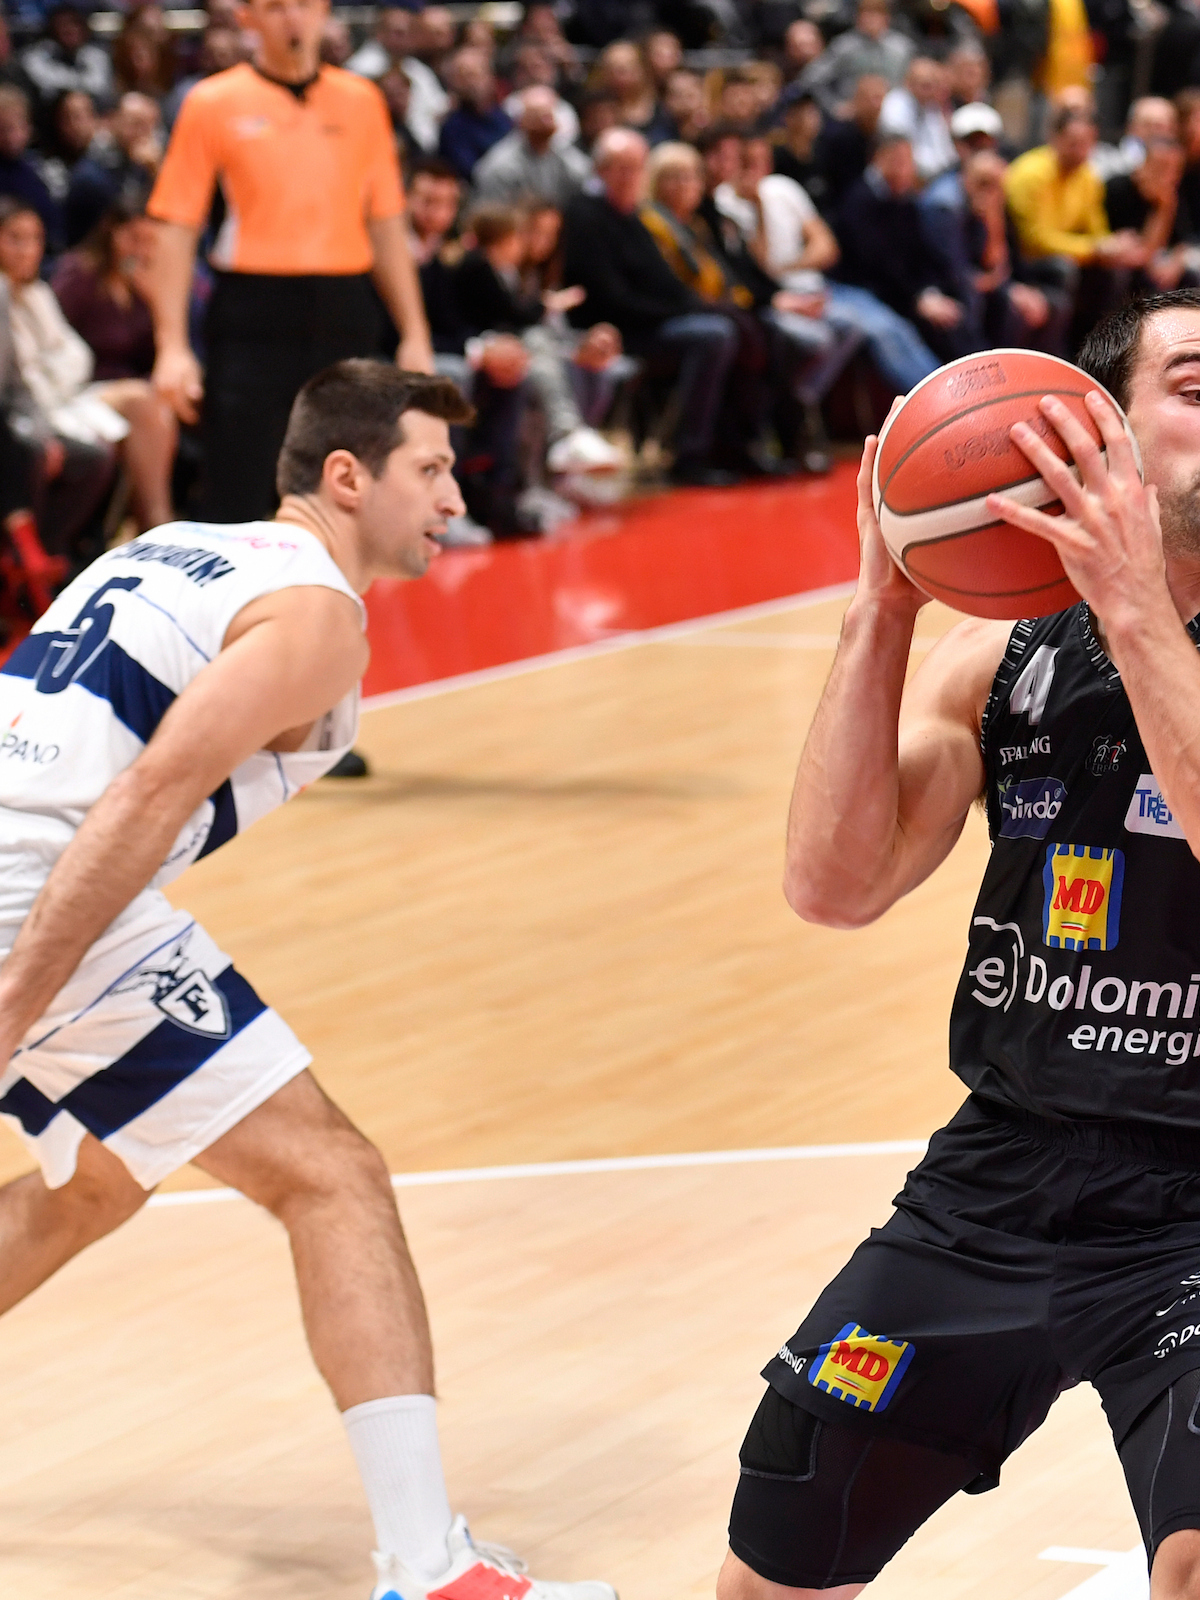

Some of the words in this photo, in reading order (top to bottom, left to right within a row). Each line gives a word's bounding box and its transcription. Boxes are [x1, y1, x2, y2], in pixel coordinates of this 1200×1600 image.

[34, 576, 144, 694] 5
[1009, 645, 1061, 726] 4
[1053, 875, 1106, 915] MD
[175, 983, 210, 1023] F
[830, 1340, 890, 1382] MD
